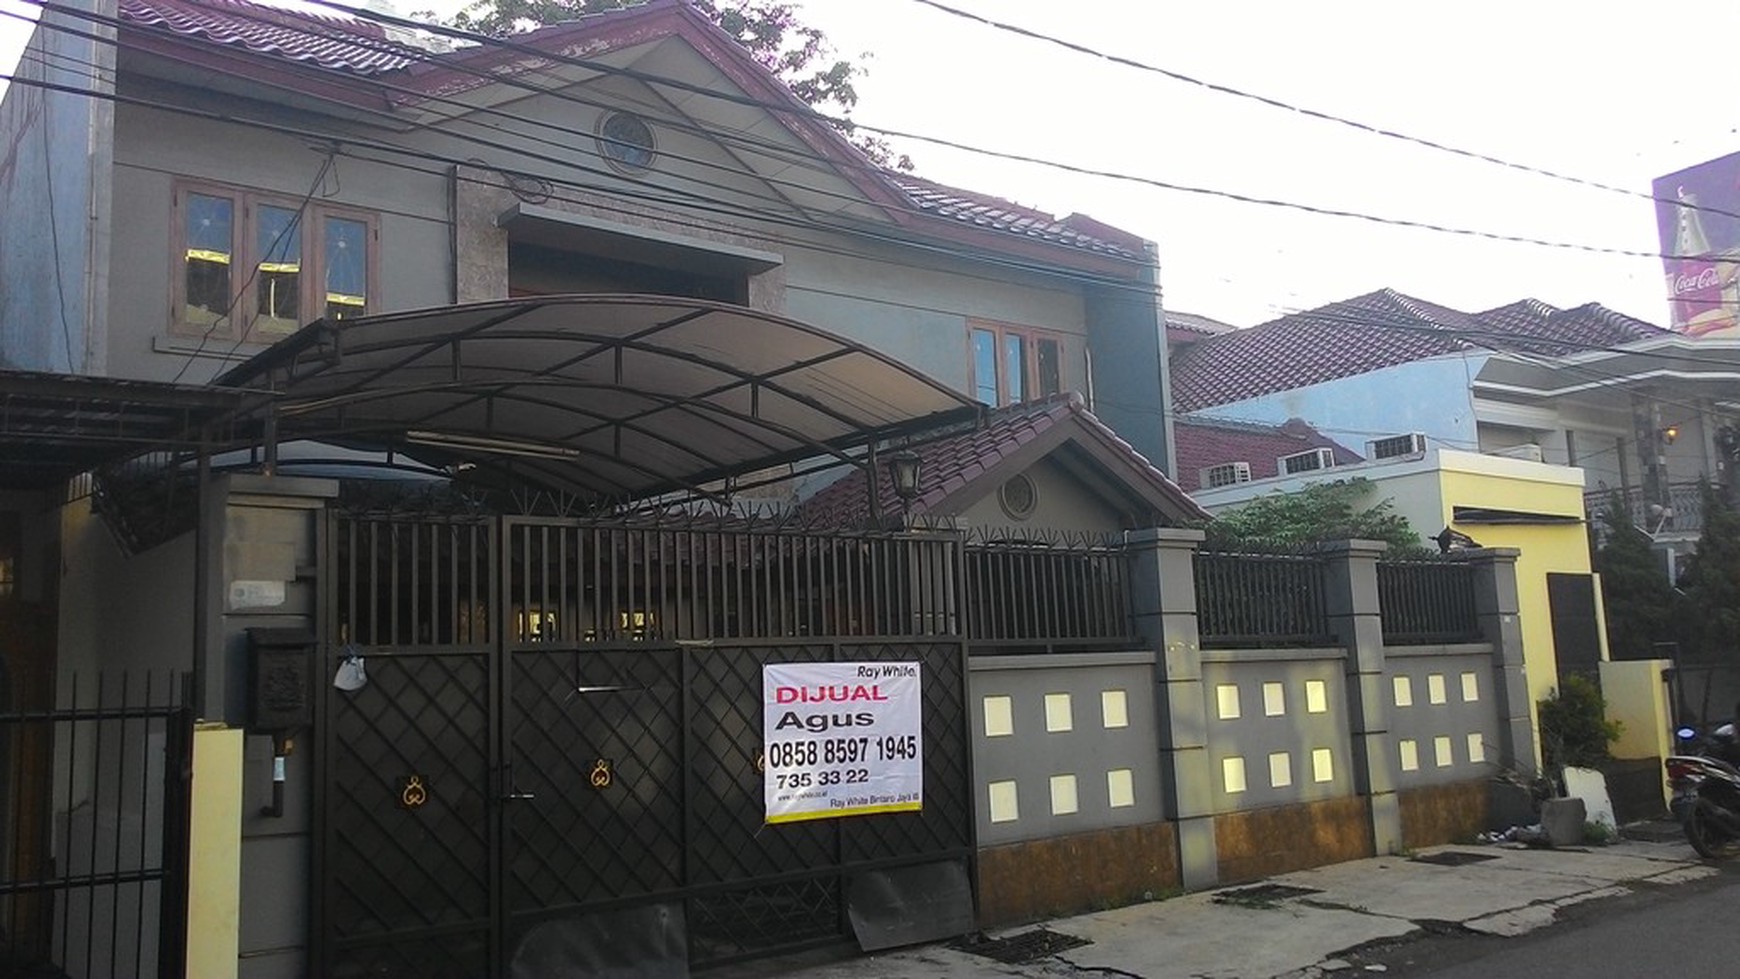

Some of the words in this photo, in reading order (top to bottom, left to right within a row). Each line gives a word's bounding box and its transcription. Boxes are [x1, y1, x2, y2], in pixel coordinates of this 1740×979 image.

[857, 665, 880, 679] Ray
[776, 685, 888, 703] DIJUAL
[775, 711, 874, 732] Agus
[769, 740, 818, 768] 0858
[824, 737, 868, 764] 8597
[877, 735, 916, 760] 1945
[776, 772, 812, 789] 735
[818, 770, 841, 786] 33
[846, 768, 869, 783] 22
[830, 798, 845, 809] Ray
[846, 796, 868, 806] White
